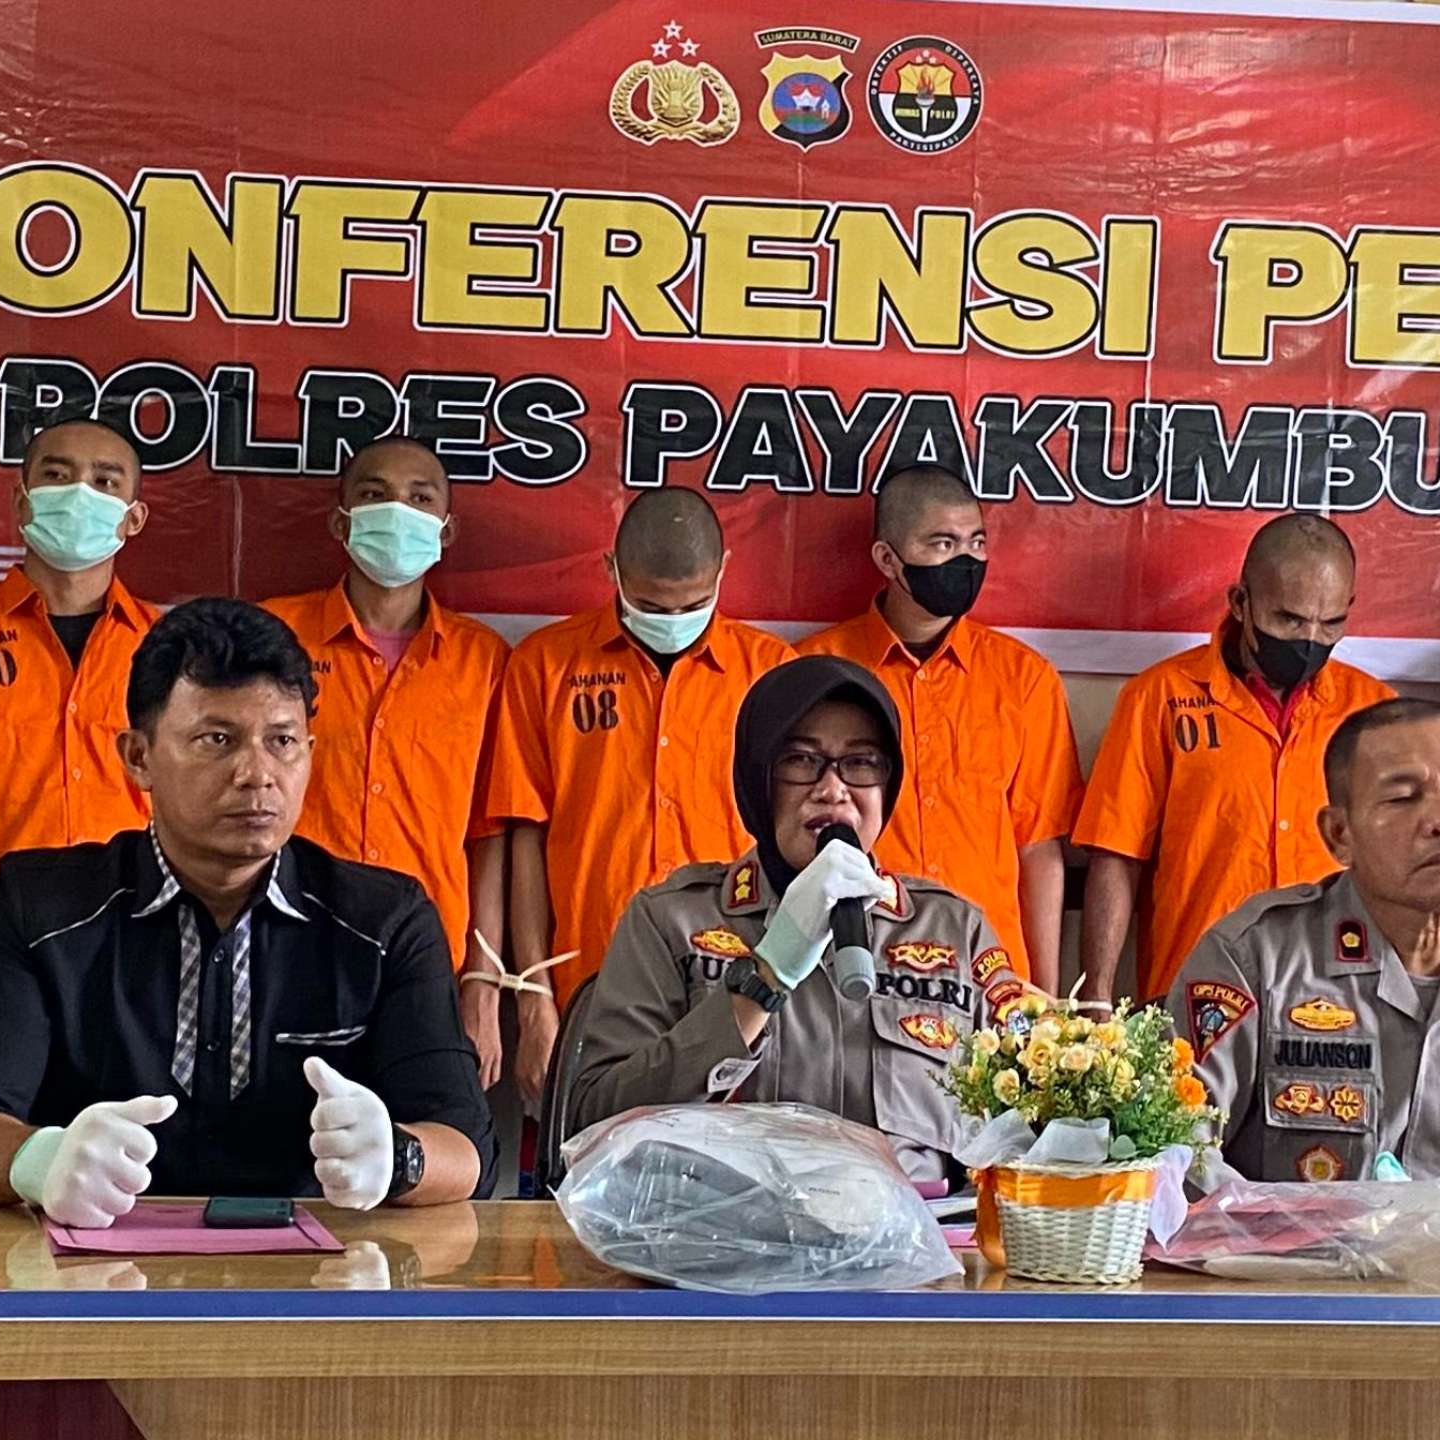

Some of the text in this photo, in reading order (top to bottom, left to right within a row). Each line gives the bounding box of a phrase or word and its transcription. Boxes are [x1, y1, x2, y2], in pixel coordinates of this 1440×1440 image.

[569, 672, 626, 688] AHANAN
[572, 689, 619, 734] 08
[1175, 712, 1221, 752] 01
[682, 954, 731, 982] YU
[876, 972, 972, 1013] POLRI
